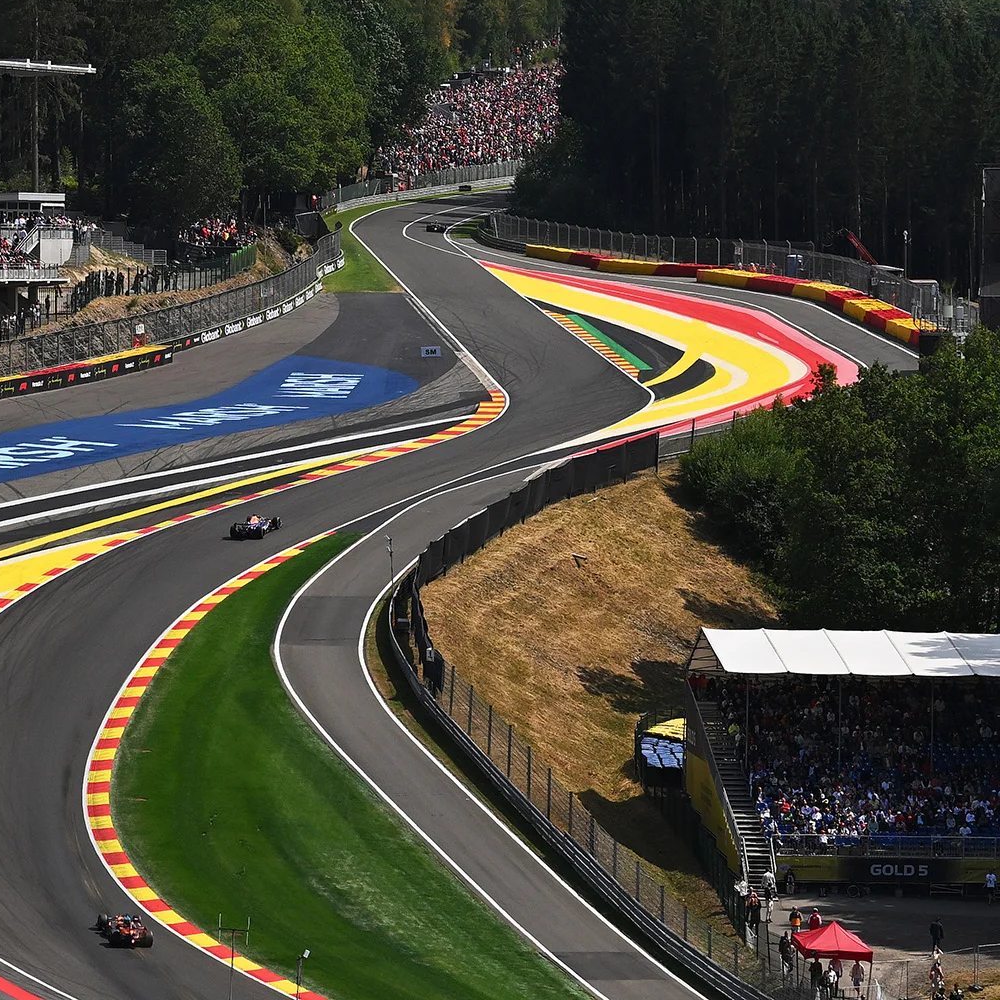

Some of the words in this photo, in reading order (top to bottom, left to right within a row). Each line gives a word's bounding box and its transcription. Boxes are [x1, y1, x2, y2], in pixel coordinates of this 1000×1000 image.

[224, 321, 242, 335] Globant
[246, 314, 262, 328] Globant
[200, 329, 220, 343] Globant
[870, 864, 915, 876] GOLD
[918, 864, 929, 876] 5
